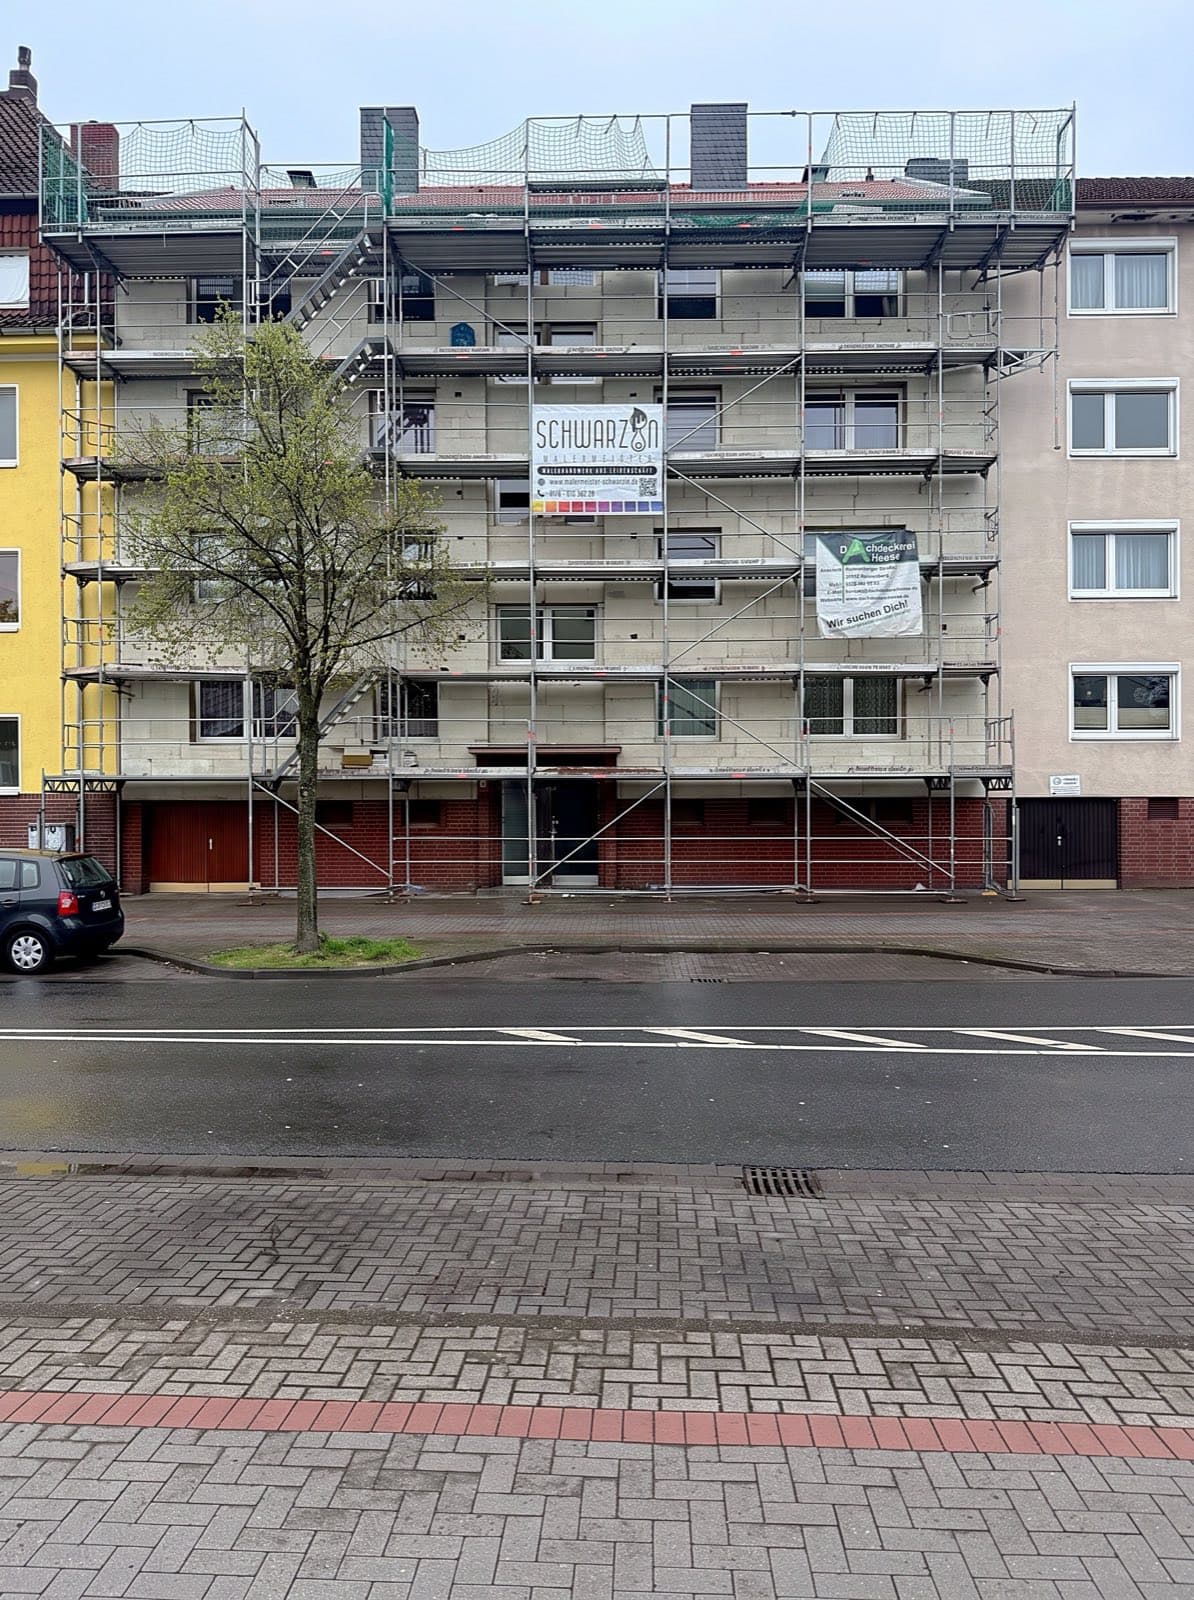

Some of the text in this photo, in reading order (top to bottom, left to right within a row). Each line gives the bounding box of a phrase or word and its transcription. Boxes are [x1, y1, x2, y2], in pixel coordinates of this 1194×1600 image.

[871, 553, 901, 563] Heese
[826, 619, 844, 629] Wir
[846, 609, 882, 625] suchen
[883, 600, 909, 613] Dich!
